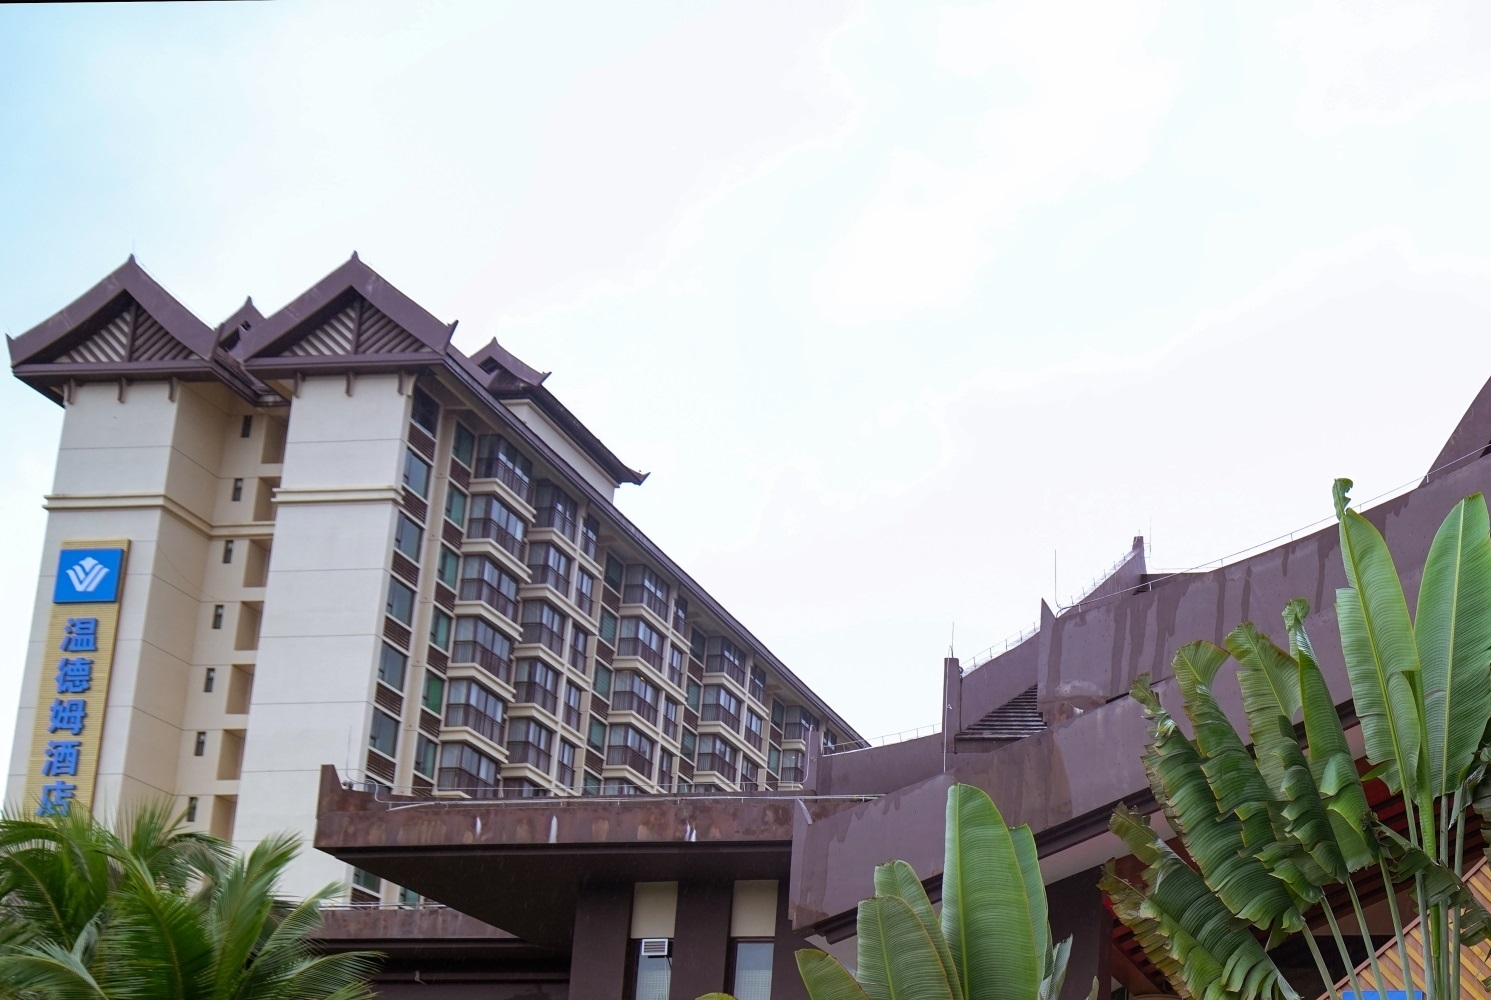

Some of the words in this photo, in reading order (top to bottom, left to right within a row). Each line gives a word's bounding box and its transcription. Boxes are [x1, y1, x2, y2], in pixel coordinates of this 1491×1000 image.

[36, 617, 98, 817] 温德姆酒店
